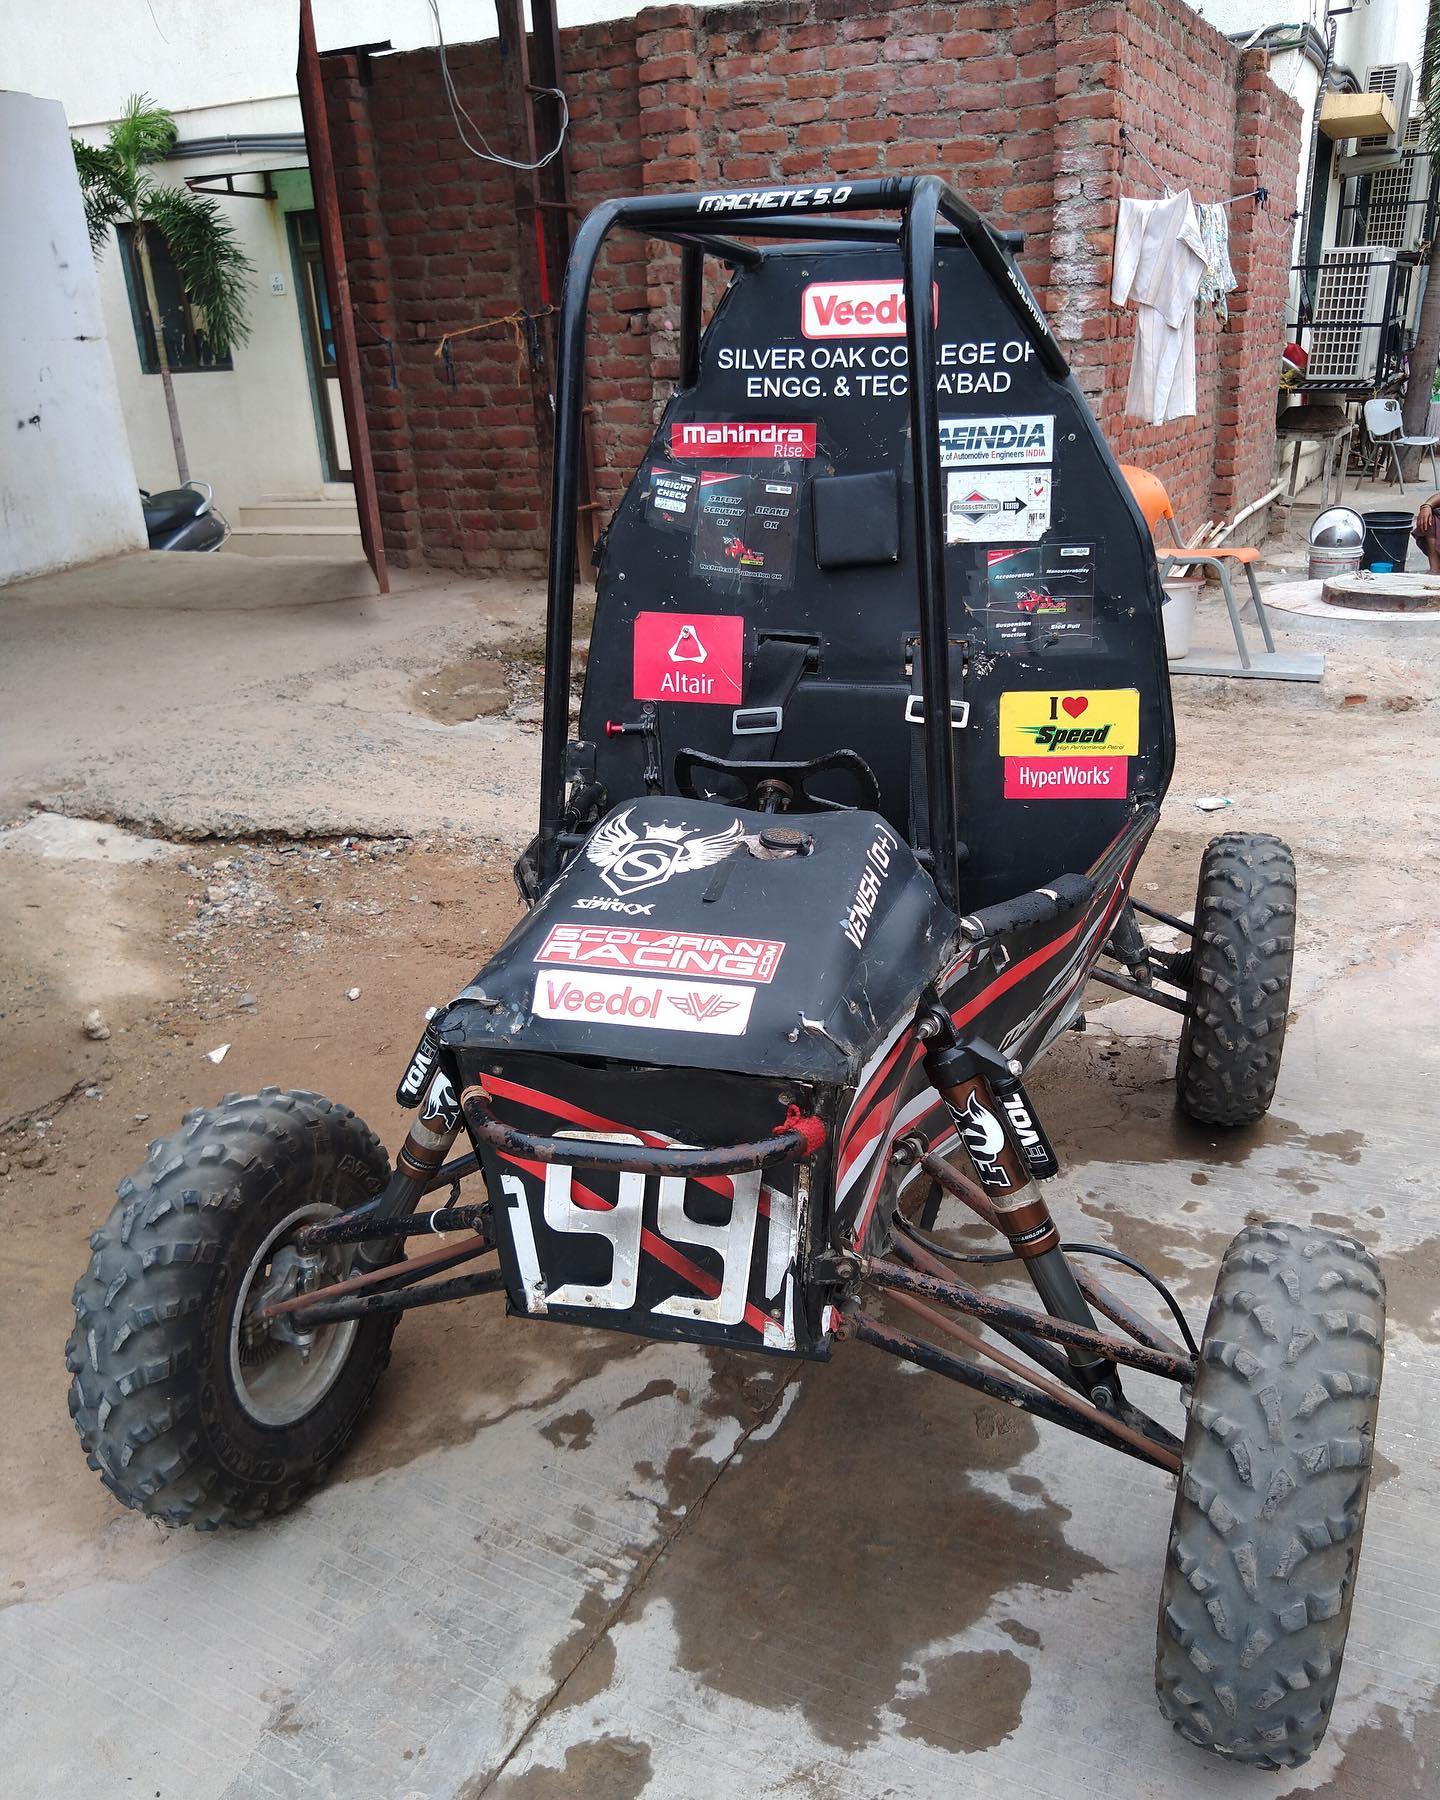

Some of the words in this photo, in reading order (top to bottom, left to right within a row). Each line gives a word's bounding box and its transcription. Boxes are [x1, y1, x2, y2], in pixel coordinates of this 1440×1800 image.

[697, 190, 814, 212] MACHETE
[812, 187, 853, 206] 5.0
[717, 348, 806, 369] SILVER
[810, 346, 867, 369] OAK
[870, 342, 997, 368] COEGE
[746, 376, 828, 398] ENGG.
[833, 375, 851, 397] &
[682, 425, 803, 444] Mahindra
[938, 423, 1046, 450] AEINDIA
[773, 444, 806, 457] Rise.
[952, 451, 990, 460] Automotive
[991, 450, 1025, 460] Engineers
[1025, 448, 1047, 458] INDIA
[656, 478, 693, 492] WEIGHT
[656, 488, 689, 501] CHECK
[708, 494, 742, 504] SAFETY
[1004, 502, 1020, 510] TESTED
[703, 505, 746, 516] SCRUTINY
[754, 505, 790, 517] BRAKE
[716, 518, 730, 527] OK
[763, 520, 780, 530] OK
[995, 621, 1032, 629] Suspension
[660, 671, 715, 695] Altair
[1049, 696, 1059, 720] I
[1034, 724, 1113, 752] Speed
[1019, 766, 1111, 789] HyperWorks
[844, 864, 882, 950] VENISH
[553, 926, 765, 958] SCOLARIAN
[541, 940, 759, 977] RACING
[547, 980, 663, 1019] Veedol
